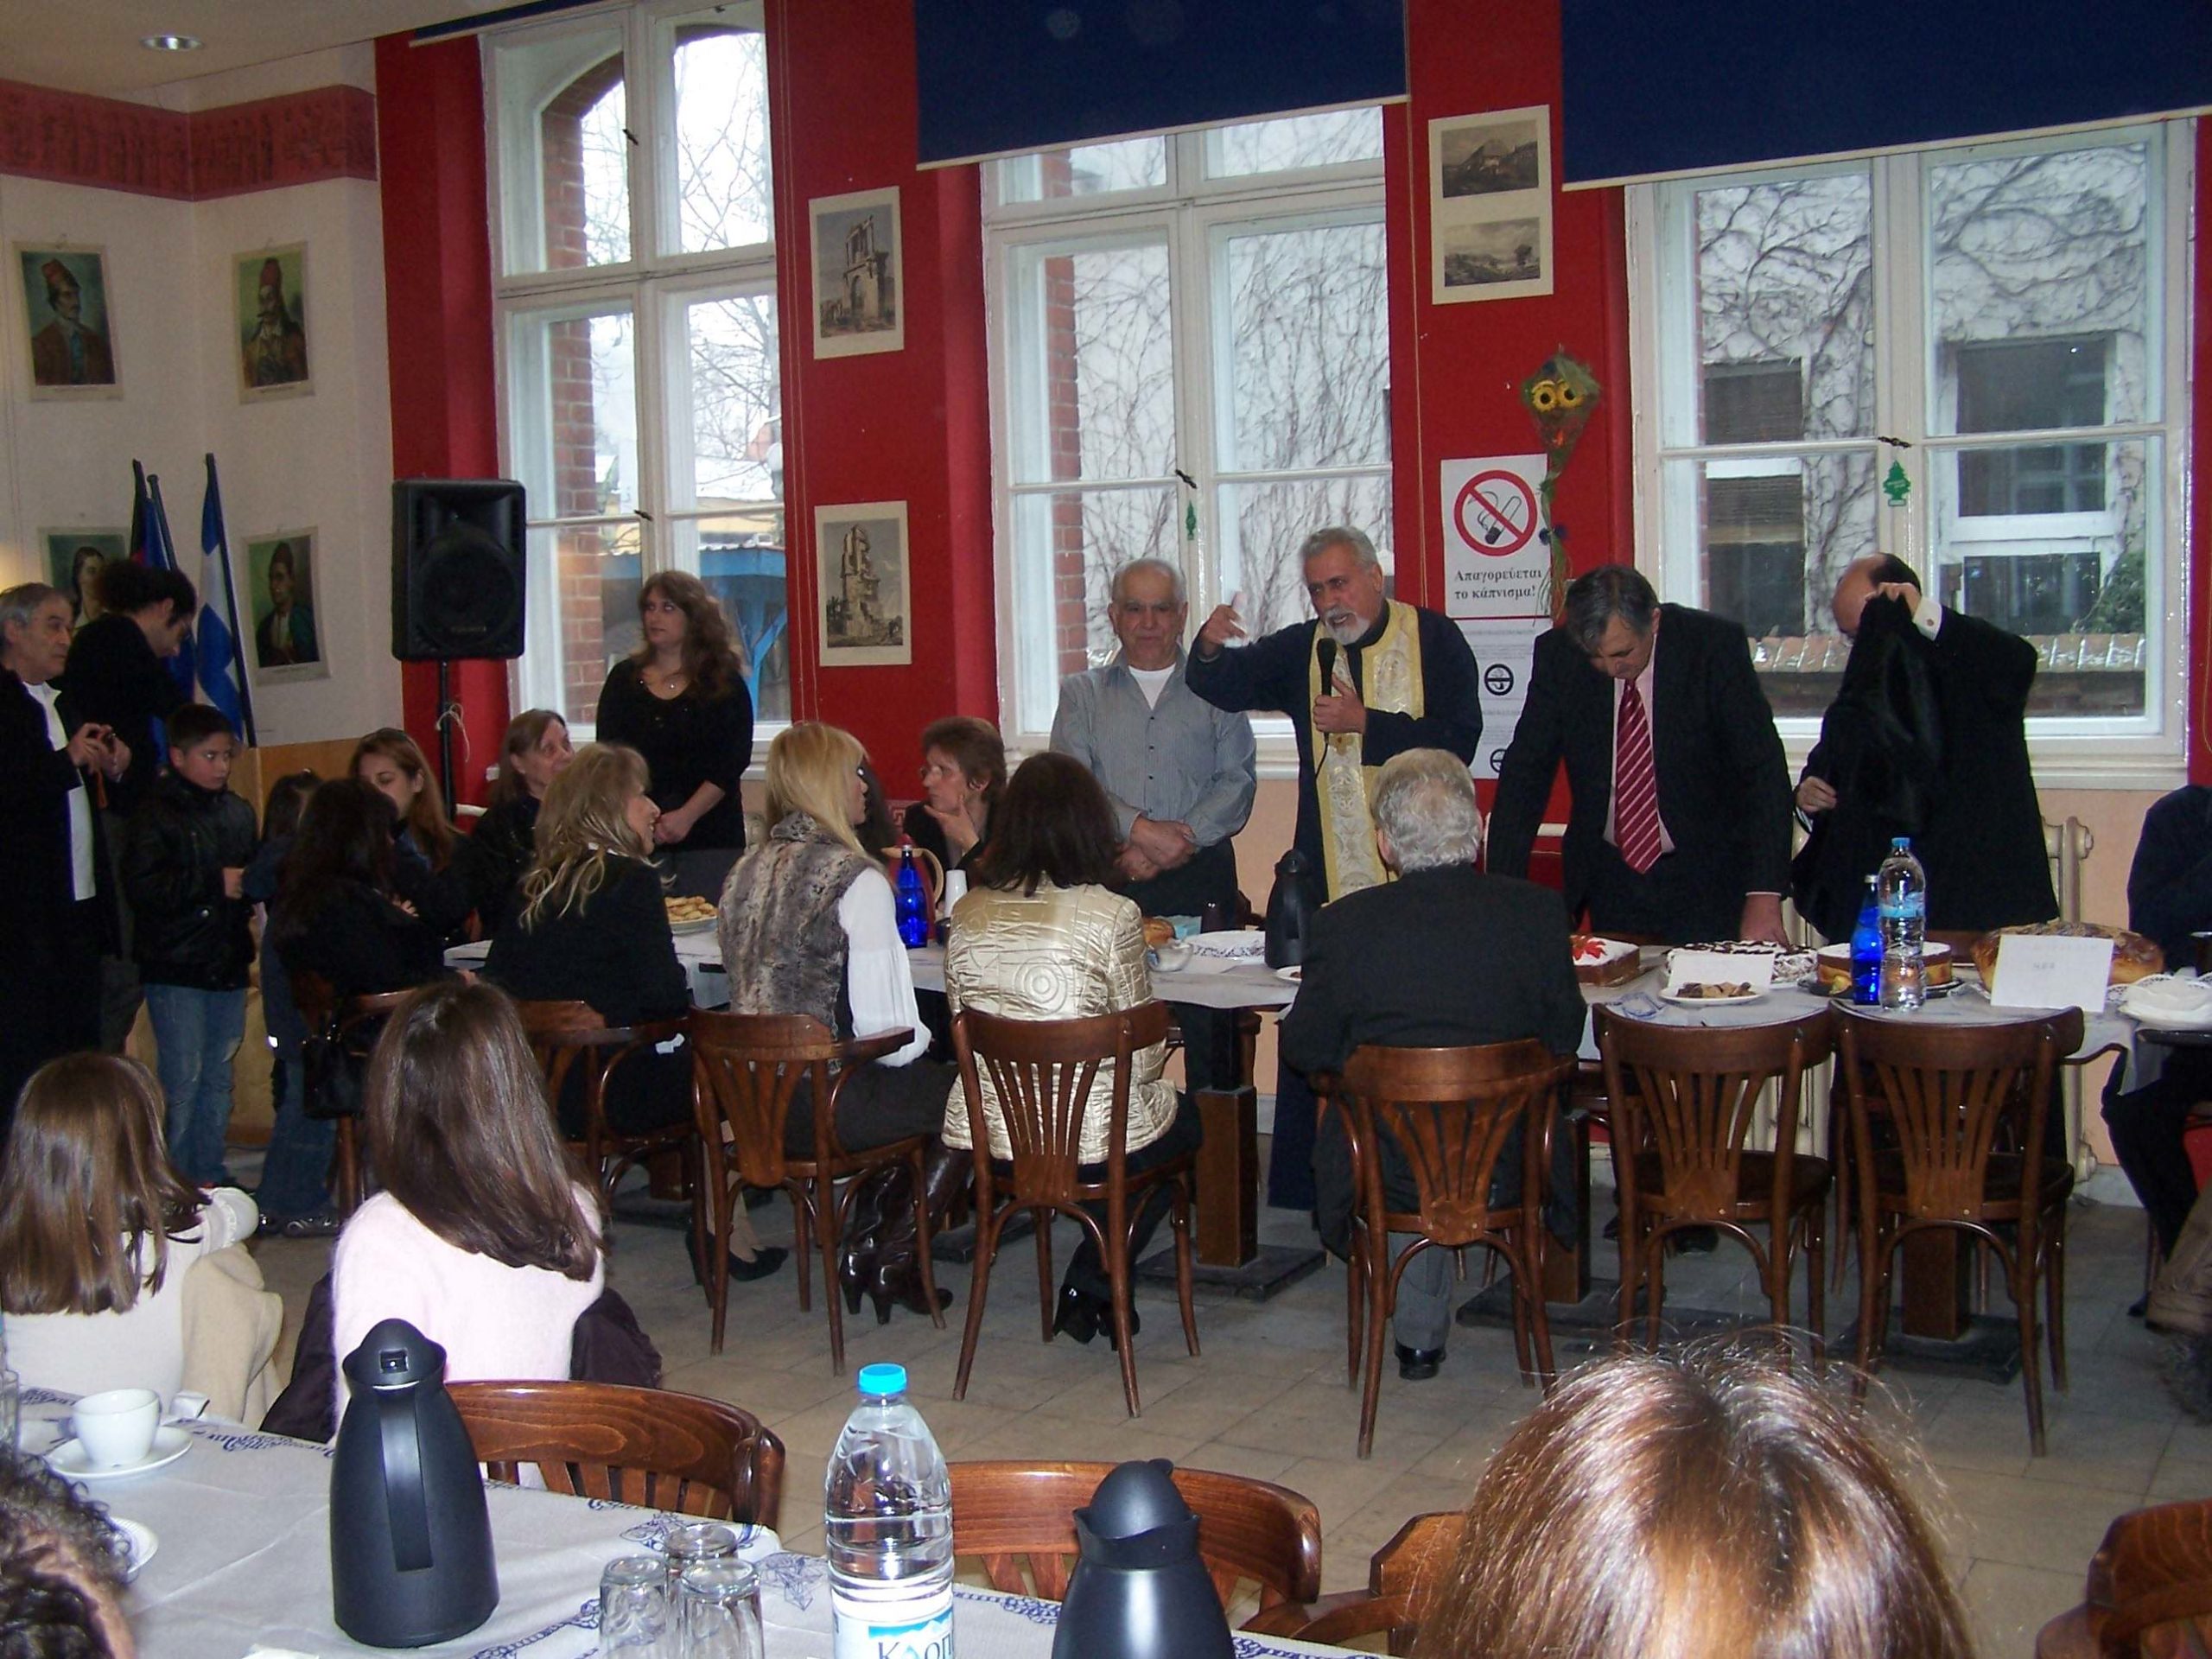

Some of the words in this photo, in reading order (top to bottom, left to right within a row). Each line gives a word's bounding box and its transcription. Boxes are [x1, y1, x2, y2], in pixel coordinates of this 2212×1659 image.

[1454, 568, 1541, 583] Απαγορεύεται
[1454, 590, 1468, 600] το
[1471, 585, 1535, 601] κάπνισμα!
